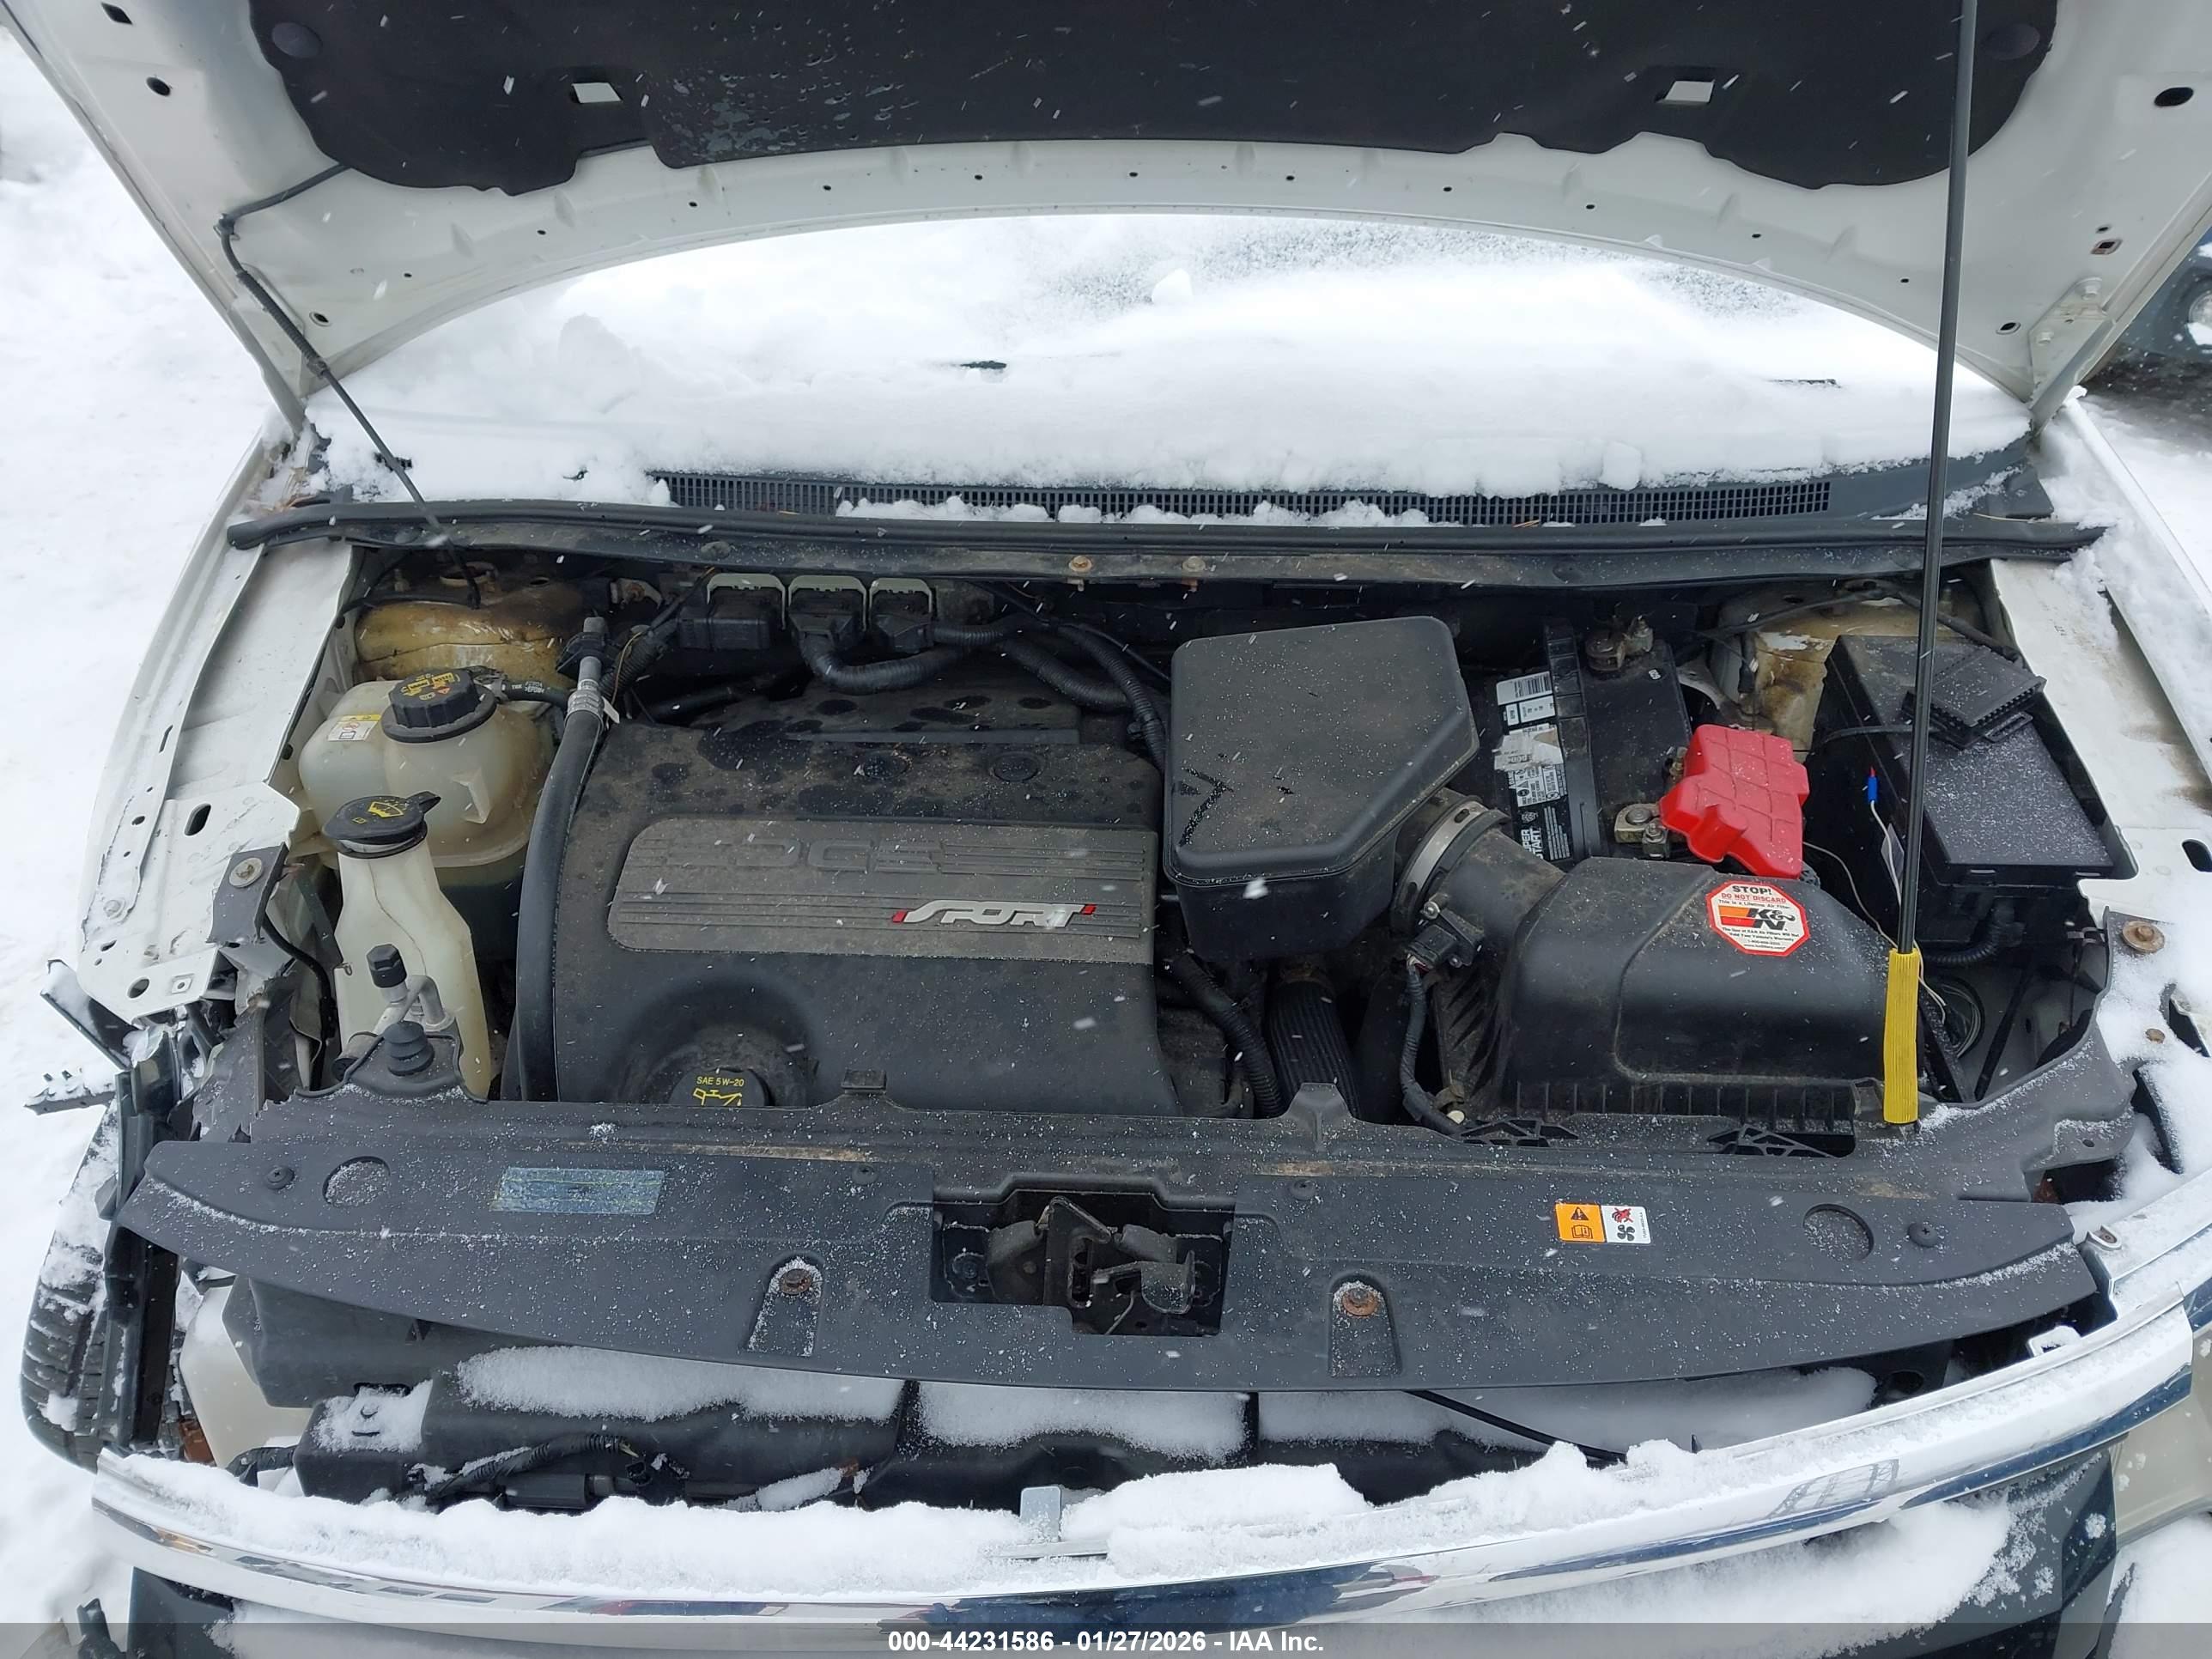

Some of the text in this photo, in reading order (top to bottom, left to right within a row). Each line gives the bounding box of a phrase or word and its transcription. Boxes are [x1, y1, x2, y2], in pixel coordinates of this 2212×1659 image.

[1521, 829, 1532, 852] UPER
[1732, 885, 1771, 895] STOP!
[1753, 895, 1786, 903] DISCARD
[903, 900, 1085, 928] SPORT
[696, 1076, 714, 1085] SAE
